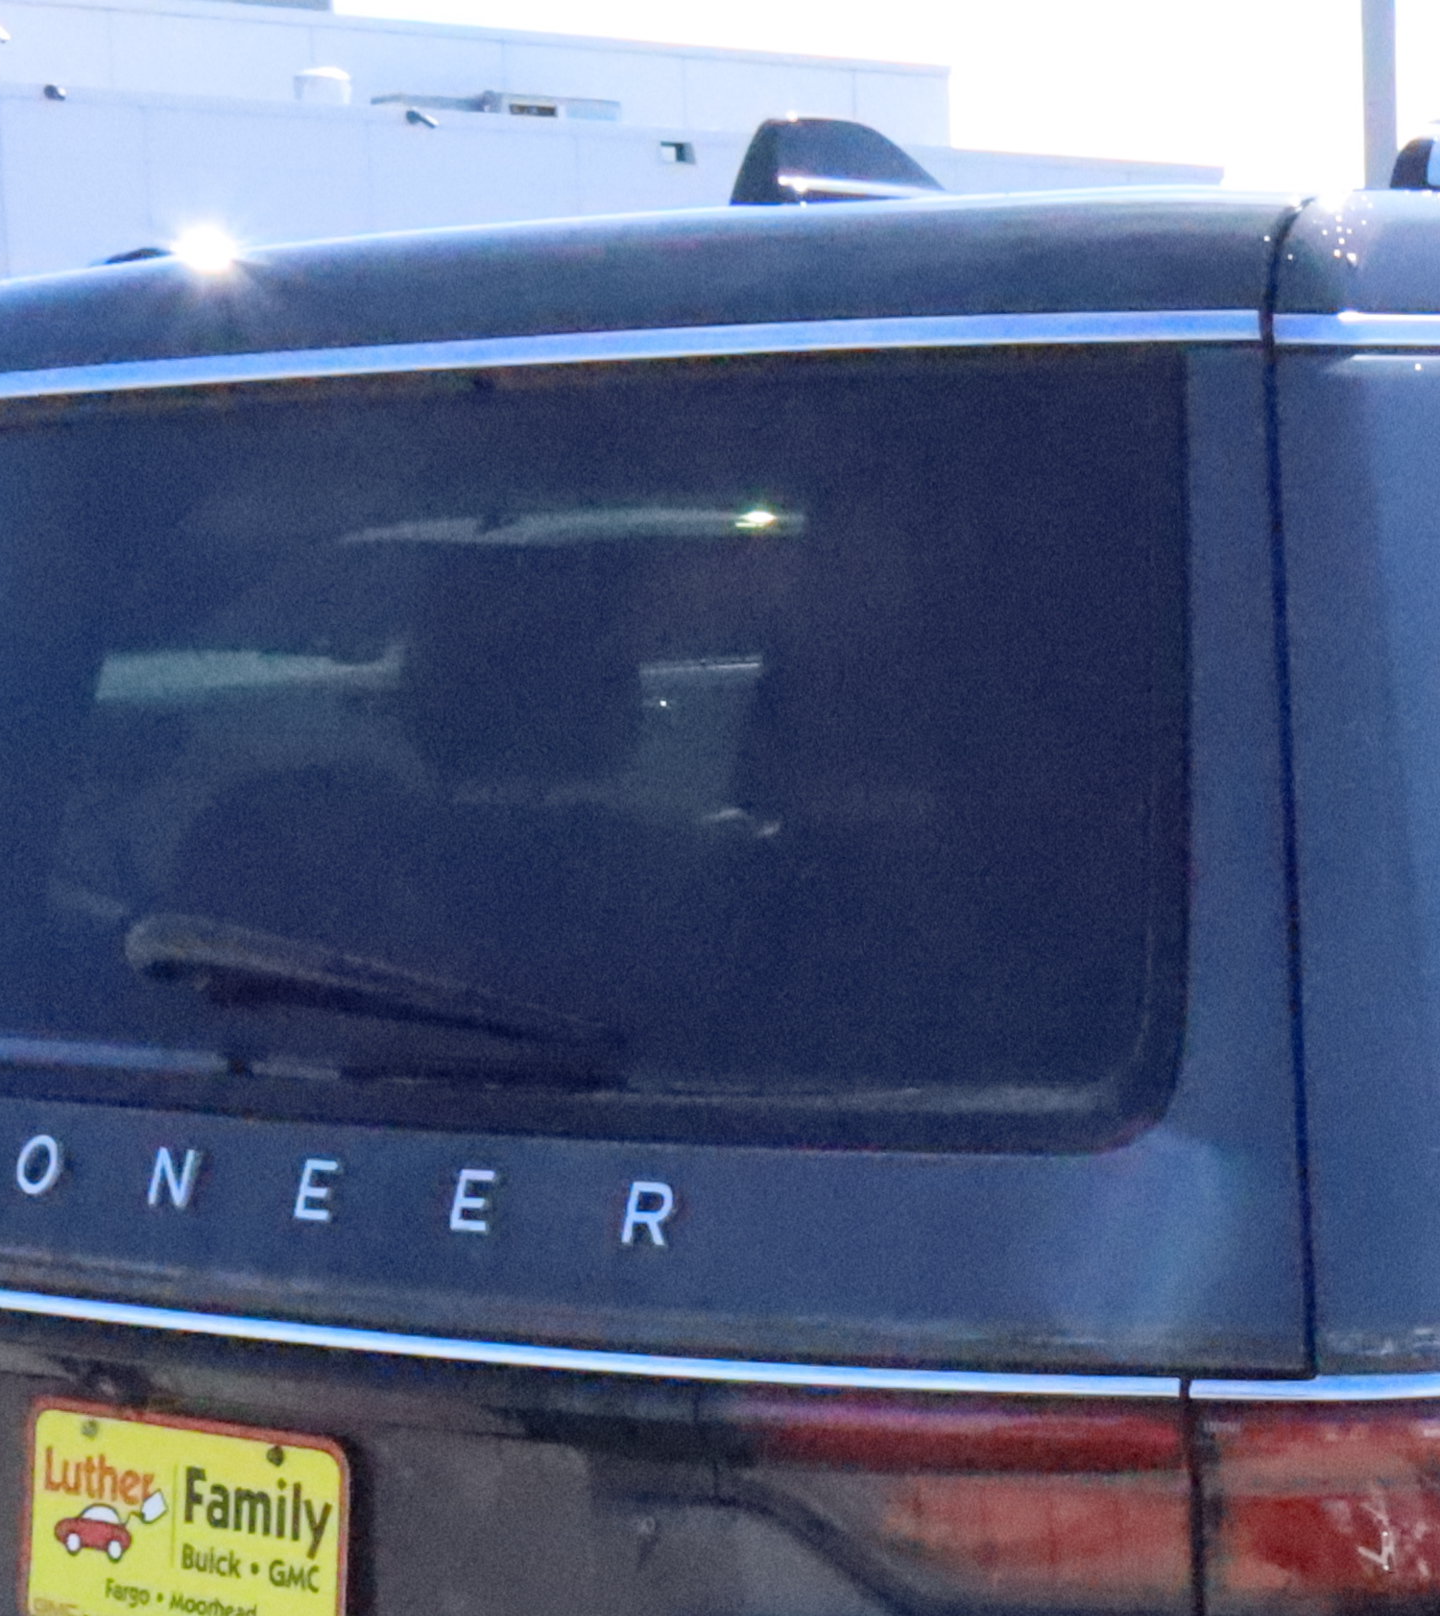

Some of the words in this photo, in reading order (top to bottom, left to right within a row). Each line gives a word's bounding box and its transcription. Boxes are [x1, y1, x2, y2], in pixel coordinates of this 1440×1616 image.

[44, 1446, 156, 1505] Luther
[184, 1465, 332, 1560] Family
[105, 1578, 150, 1608] Fargo
[181, 1543, 241, 1578] Buick
[268, 1559, 321, 1593] GMC
